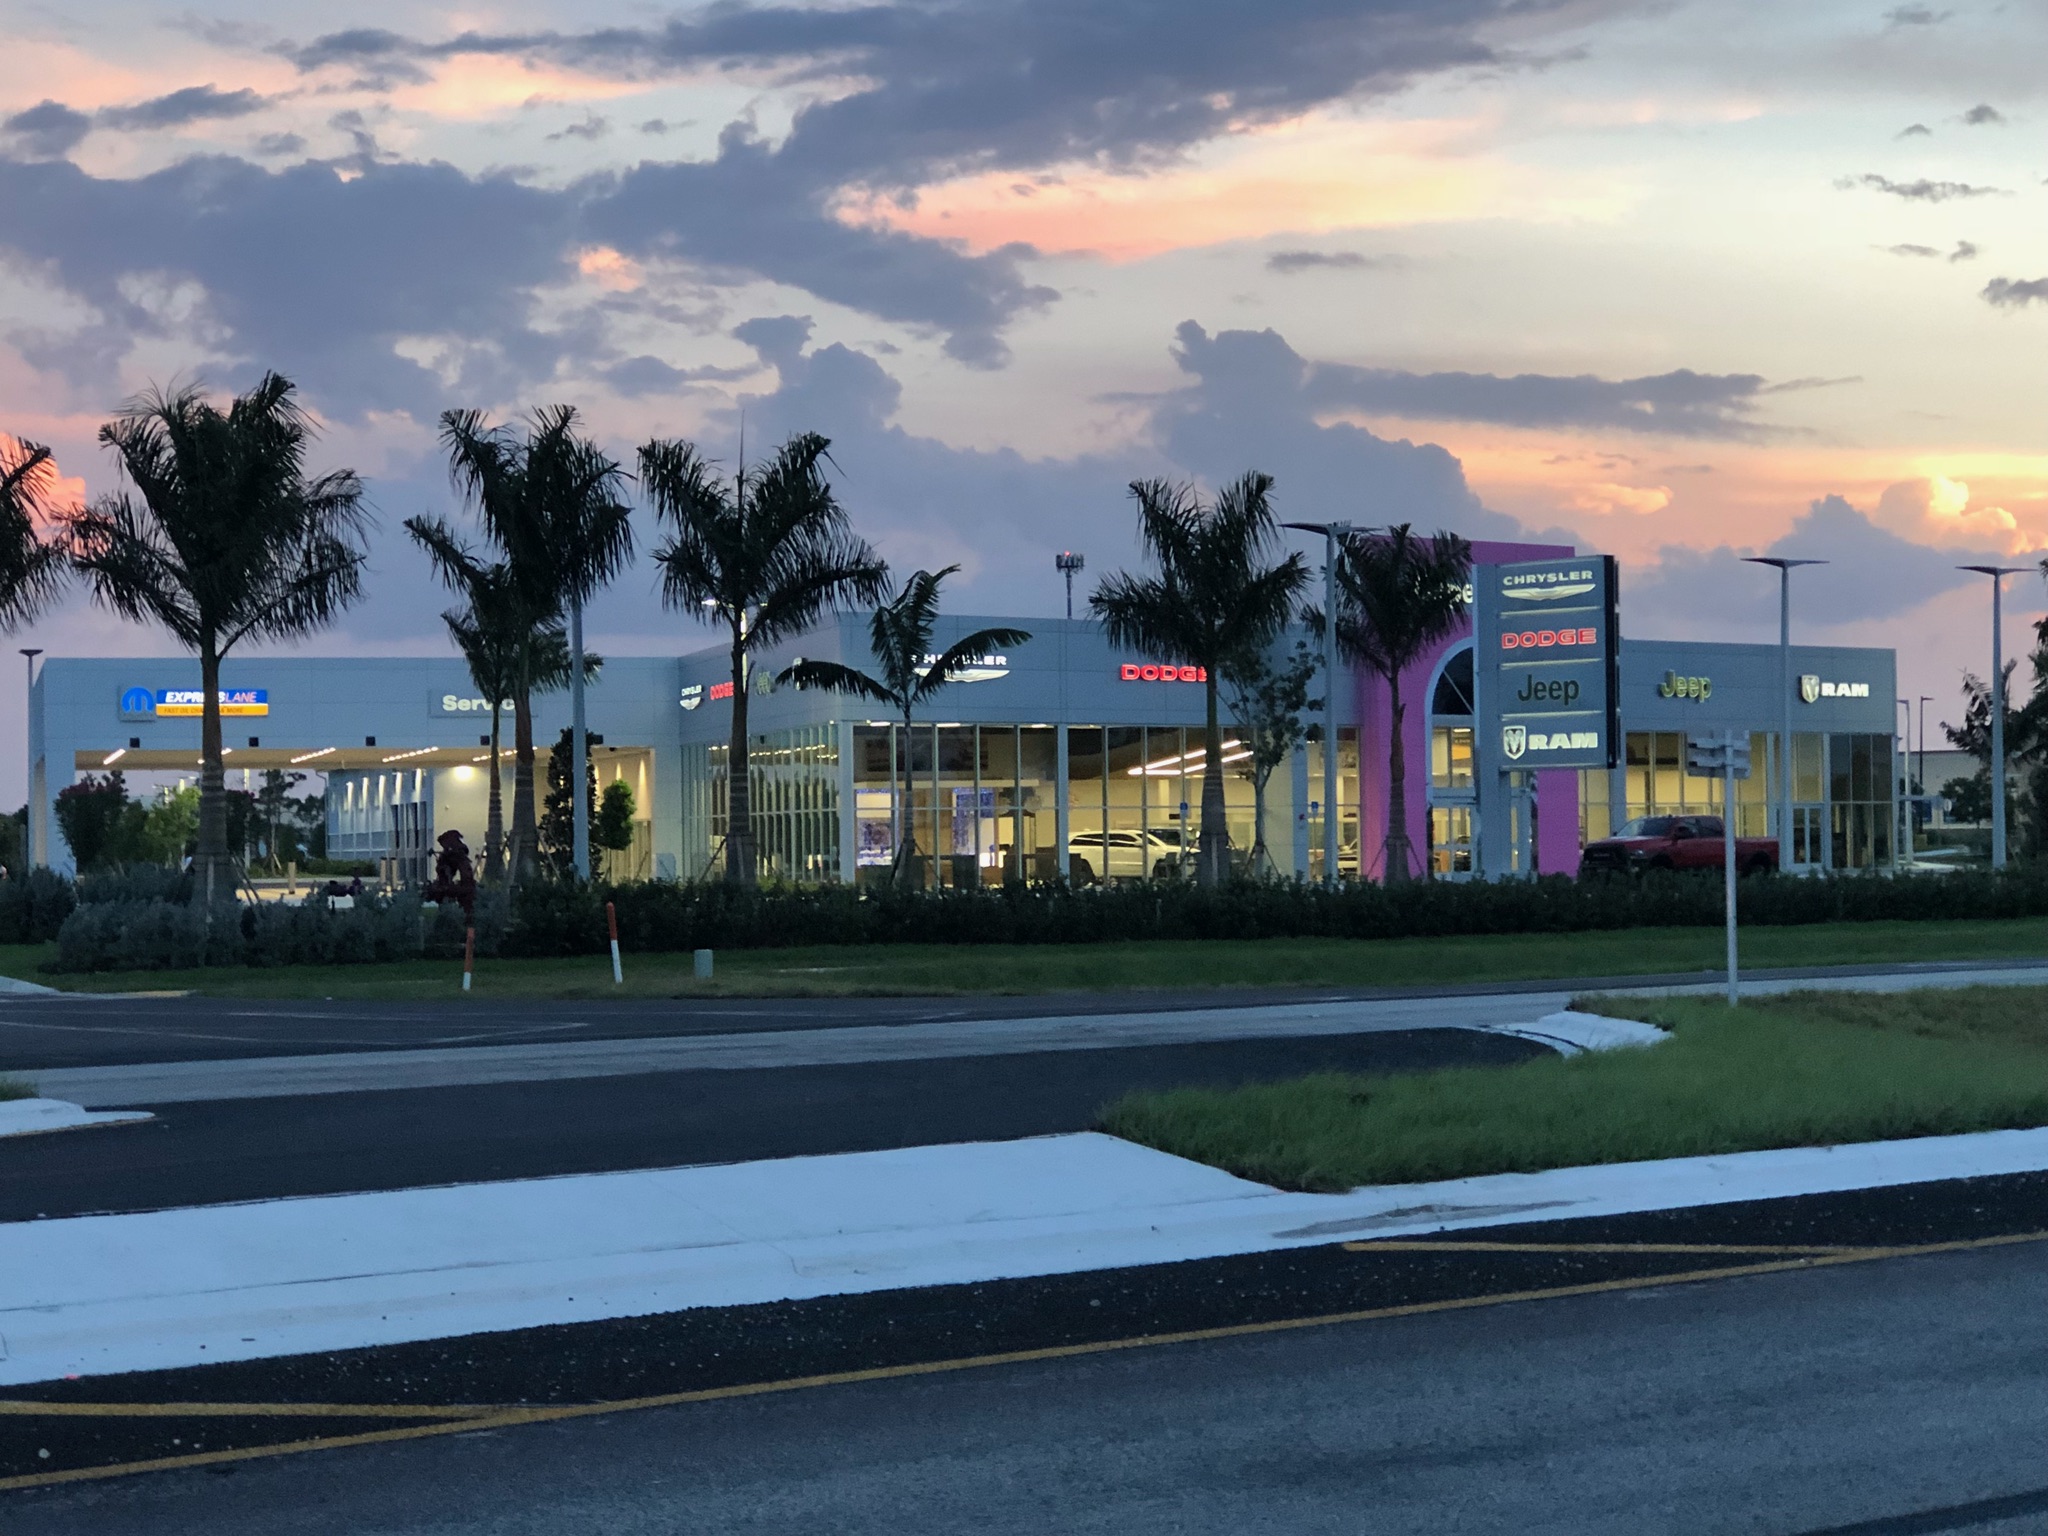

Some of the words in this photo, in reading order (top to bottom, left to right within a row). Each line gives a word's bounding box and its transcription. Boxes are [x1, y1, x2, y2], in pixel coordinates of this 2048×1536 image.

[1503, 570, 1593, 586] CHRYSLER
[1501, 628, 1597, 649] DODGE
[1517, 674, 1579, 706] Jeep
[1661, 669, 1712, 703] Jeep
[1821, 682, 1869, 697] RAM
[442, 694, 515, 711] Servc
[1529, 732, 1598, 750] RAM
